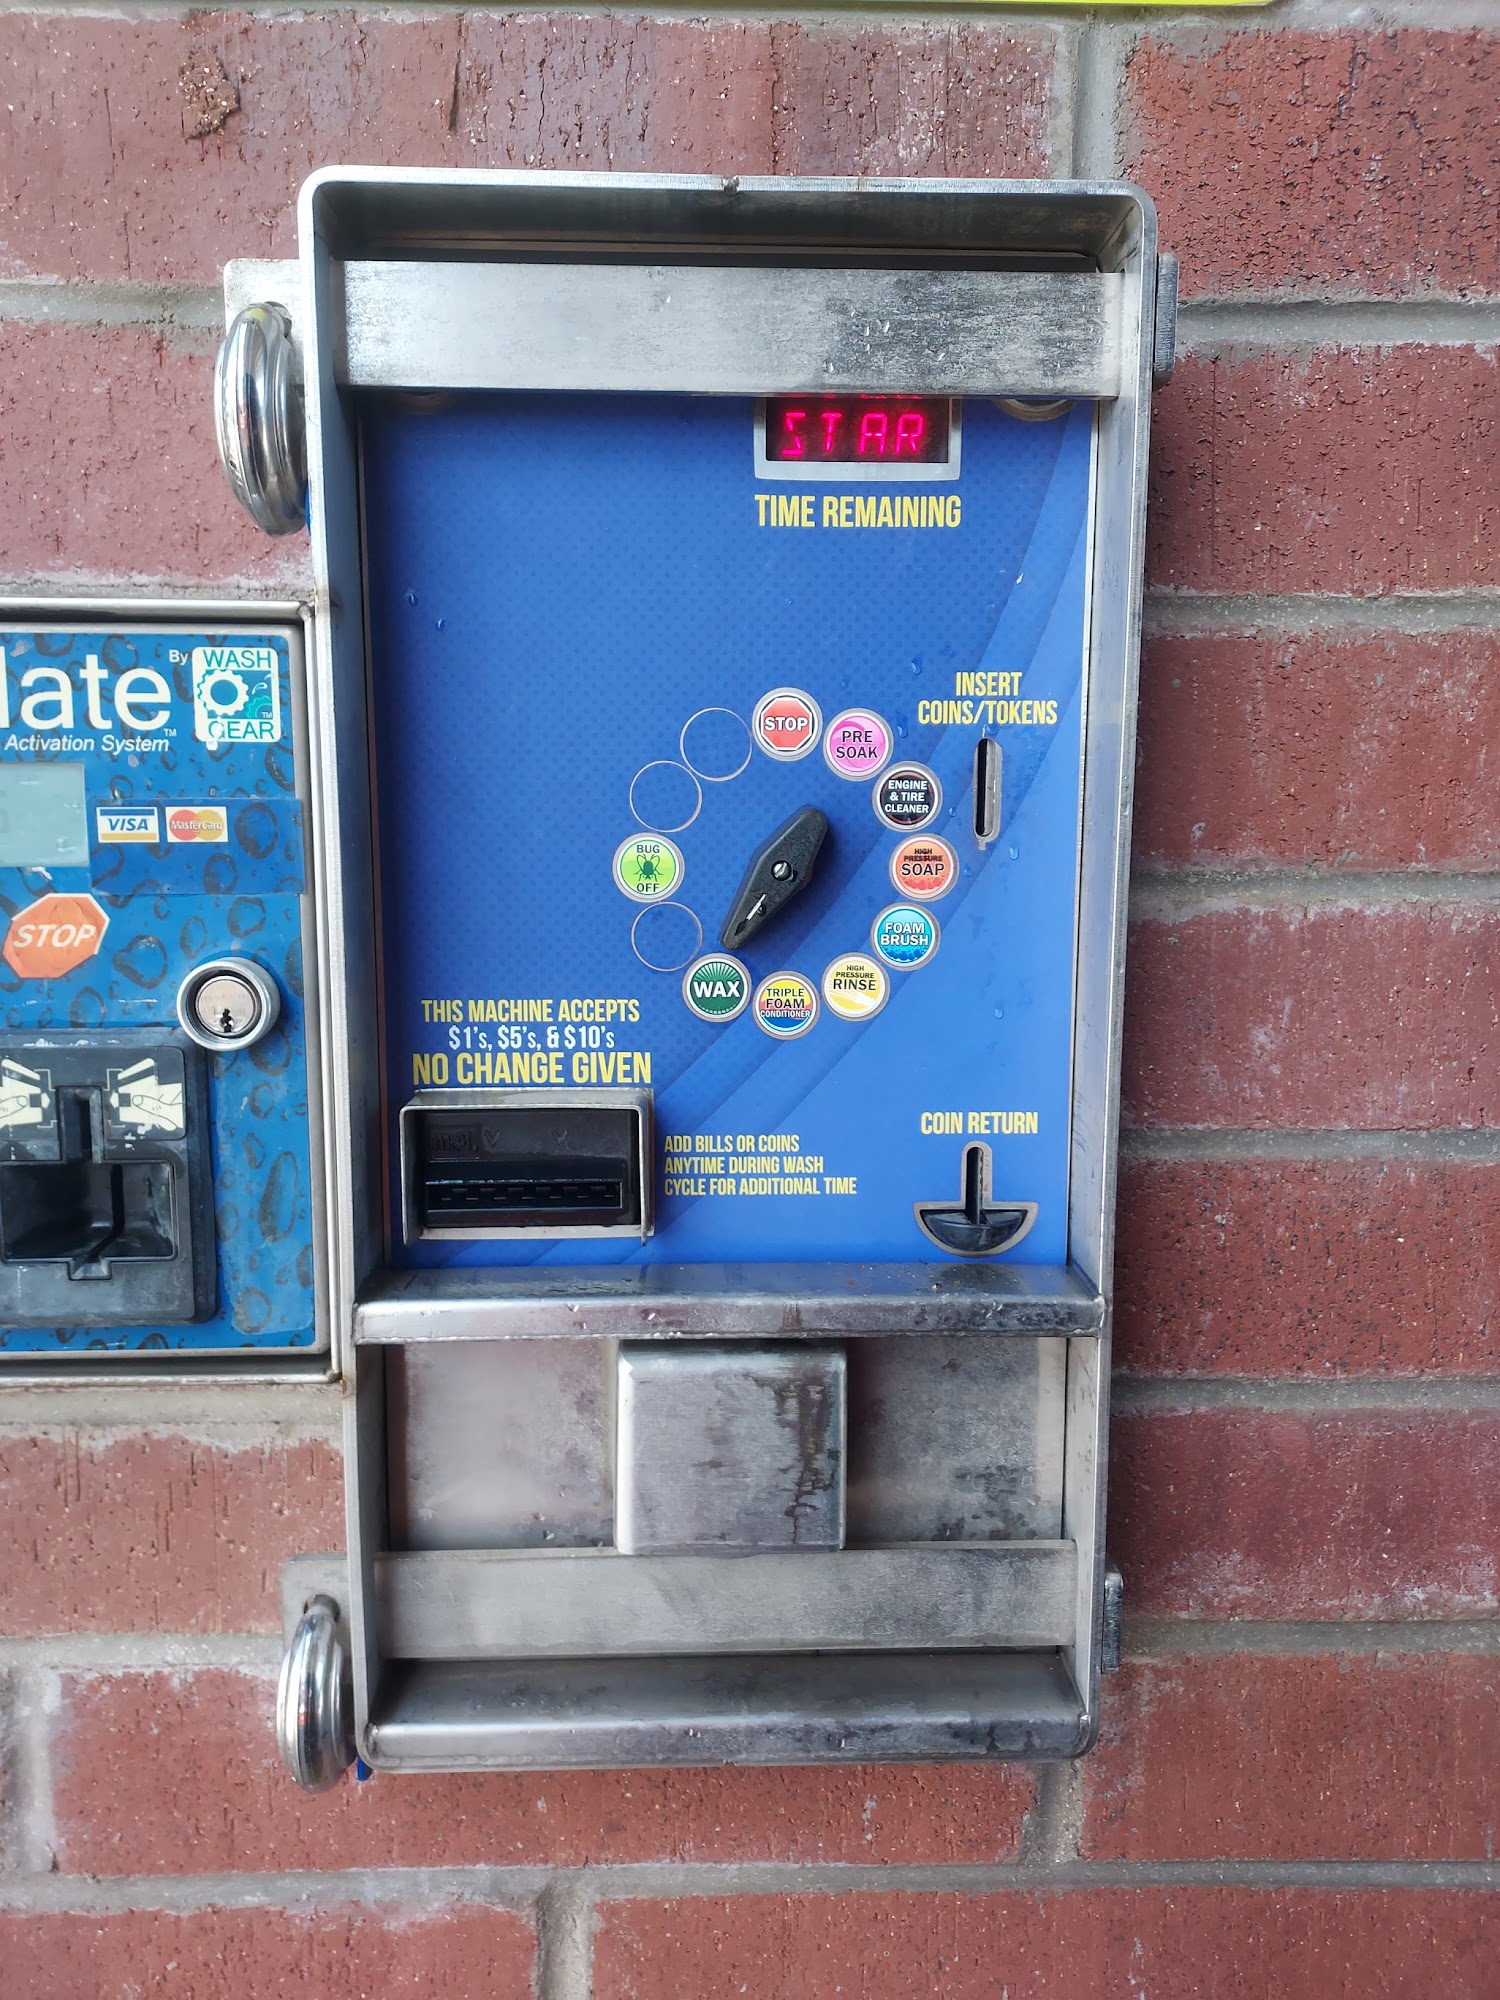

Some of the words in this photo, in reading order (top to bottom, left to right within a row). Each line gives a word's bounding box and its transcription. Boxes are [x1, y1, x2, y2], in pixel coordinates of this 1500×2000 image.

[782, 412, 924, 455] STAR
[755, 494, 815, 526] TIME
[823, 496, 961, 527] REMAINING
[169, 650, 188, 664] By
[203, 650, 272, 668] WASH
[956, 672, 1022, 695] INSERT
[918, 700, 1058, 724] COINS/TOKENS
[208, 722, 275, 739] GEAR
[764, 717, 807, 731] STOP
[842, 731, 873, 743] PRE
[5, 734, 95, 751] Activation
[101, 735, 169, 755] System
[836, 747, 878, 759] SOAK
[888, 780, 927, 790] ENGINE
[890, 793, 899, 801] &
[902, 792, 925, 801] TIRE
[885, 804, 929, 813] CLEANER
[108, 818, 149, 831] VISA
[171, 819, 222, 831] MasterCard
[636, 845, 660, 854] BUG
[901, 863, 945, 876] SOAP
[636, 883, 660, 893] OFF
[885, 922, 925, 934] FOAM
[14, 923, 96, 948] STOP
[881, 934, 929, 946] BRUSH
[693, 981, 740, 998] WAX
[833, 979, 876, 991] RINSE
[766, 988, 804, 997] TRIPLE
[421, 1000, 463, 1022] THIS
[468, 1000, 553, 1022] MACHINE
[558, 999, 640, 1022] ACCEPTS
[765, 998, 805, 1009] FOAM
[760, 1010, 810, 1018] CONDITIONER
[412, 1053, 448, 1085] NO
[456, 1053, 565, 1084] CHANGE
[572, 1052, 651, 1083] GIVEN
[921, 1112, 961, 1134] COIN
[968, 1112, 1038, 1134] RETURN
[664, 1136, 692, 1152] ADD
[695, 1136, 733, 1152] BILLS
[736, 1135, 755, 1152] OR
[758, 1135, 800, 1152] COINS
[664, 1157, 725, 1174] ANYTIME
[729, 1157, 780, 1174] DURING
[783, 1156, 824, 1173] WASH
[664, 1179, 706, 1195] CYCLE
[709, 1178, 736, 1195] FOR
[739, 1177, 820, 1195] ADDITIONAL
[823, 1177, 857, 1194] TIME
